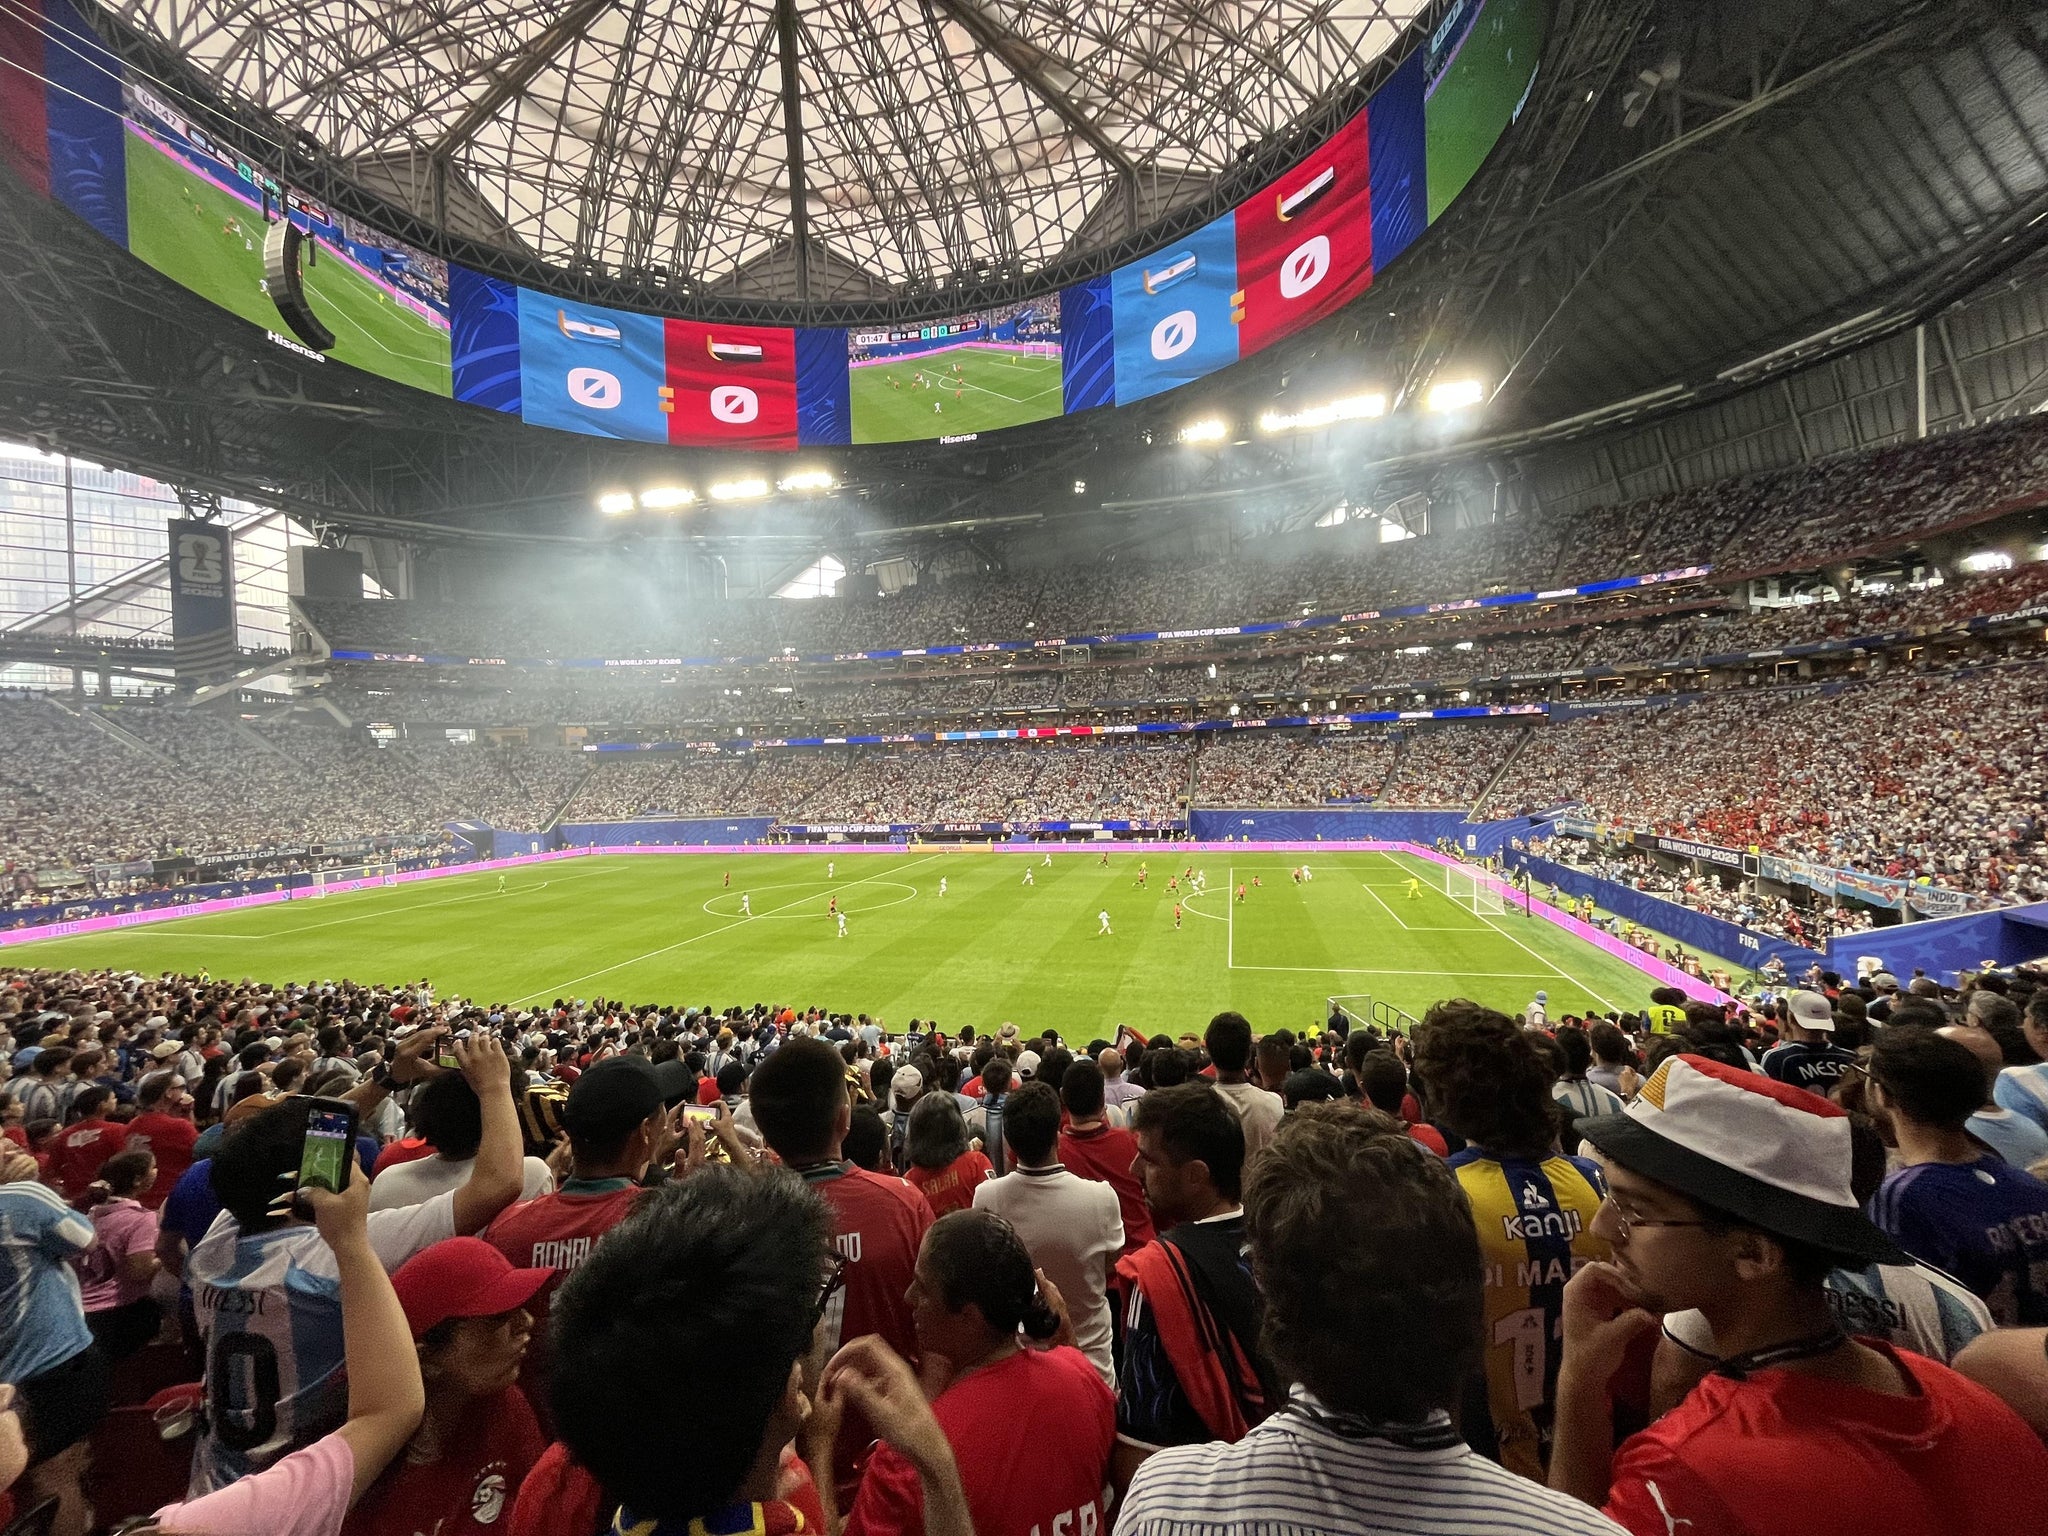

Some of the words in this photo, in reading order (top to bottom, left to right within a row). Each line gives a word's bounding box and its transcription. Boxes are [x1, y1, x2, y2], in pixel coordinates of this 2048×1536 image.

[861, 335, 883, 343] 01:47
[268, 330, 325, 362] Hisense
[940, 433, 977, 444] Hisense
[1340, 611, 1380, 622] ATLANTA
[1988, 606, 2048, 623] ATLANTA
[1174, 630, 1199, 638] WORLD
[1034, 639, 1066, 647] ATLANTA
[1525, 671, 1547, 679] WORLD
[1371, 682, 1411, 690] ATLANTA
[1232, 719, 1266, 728] ATLANTA
[864, 825, 890, 833] 2026
[943, 824, 982, 832] ATLANTA
[224, 853, 257, 862] WORLD
[259, 850, 277, 859] CUP
[1658, 838, 1672, 850] FIFA
[1672, 841, 1696, 855] WORLD
[1696, 845, 1712, 859] CUP
[1711, 849, 1739, 864] 2026
[1928, 891, 1957, 903] INDIO
[48, 922, 79, 936] THIS
[1739, 933, 1759, 950] FIFA
[1799, 1061, 1849, 1080] MESS
[922, 1170, 959, 1197] SALAH
